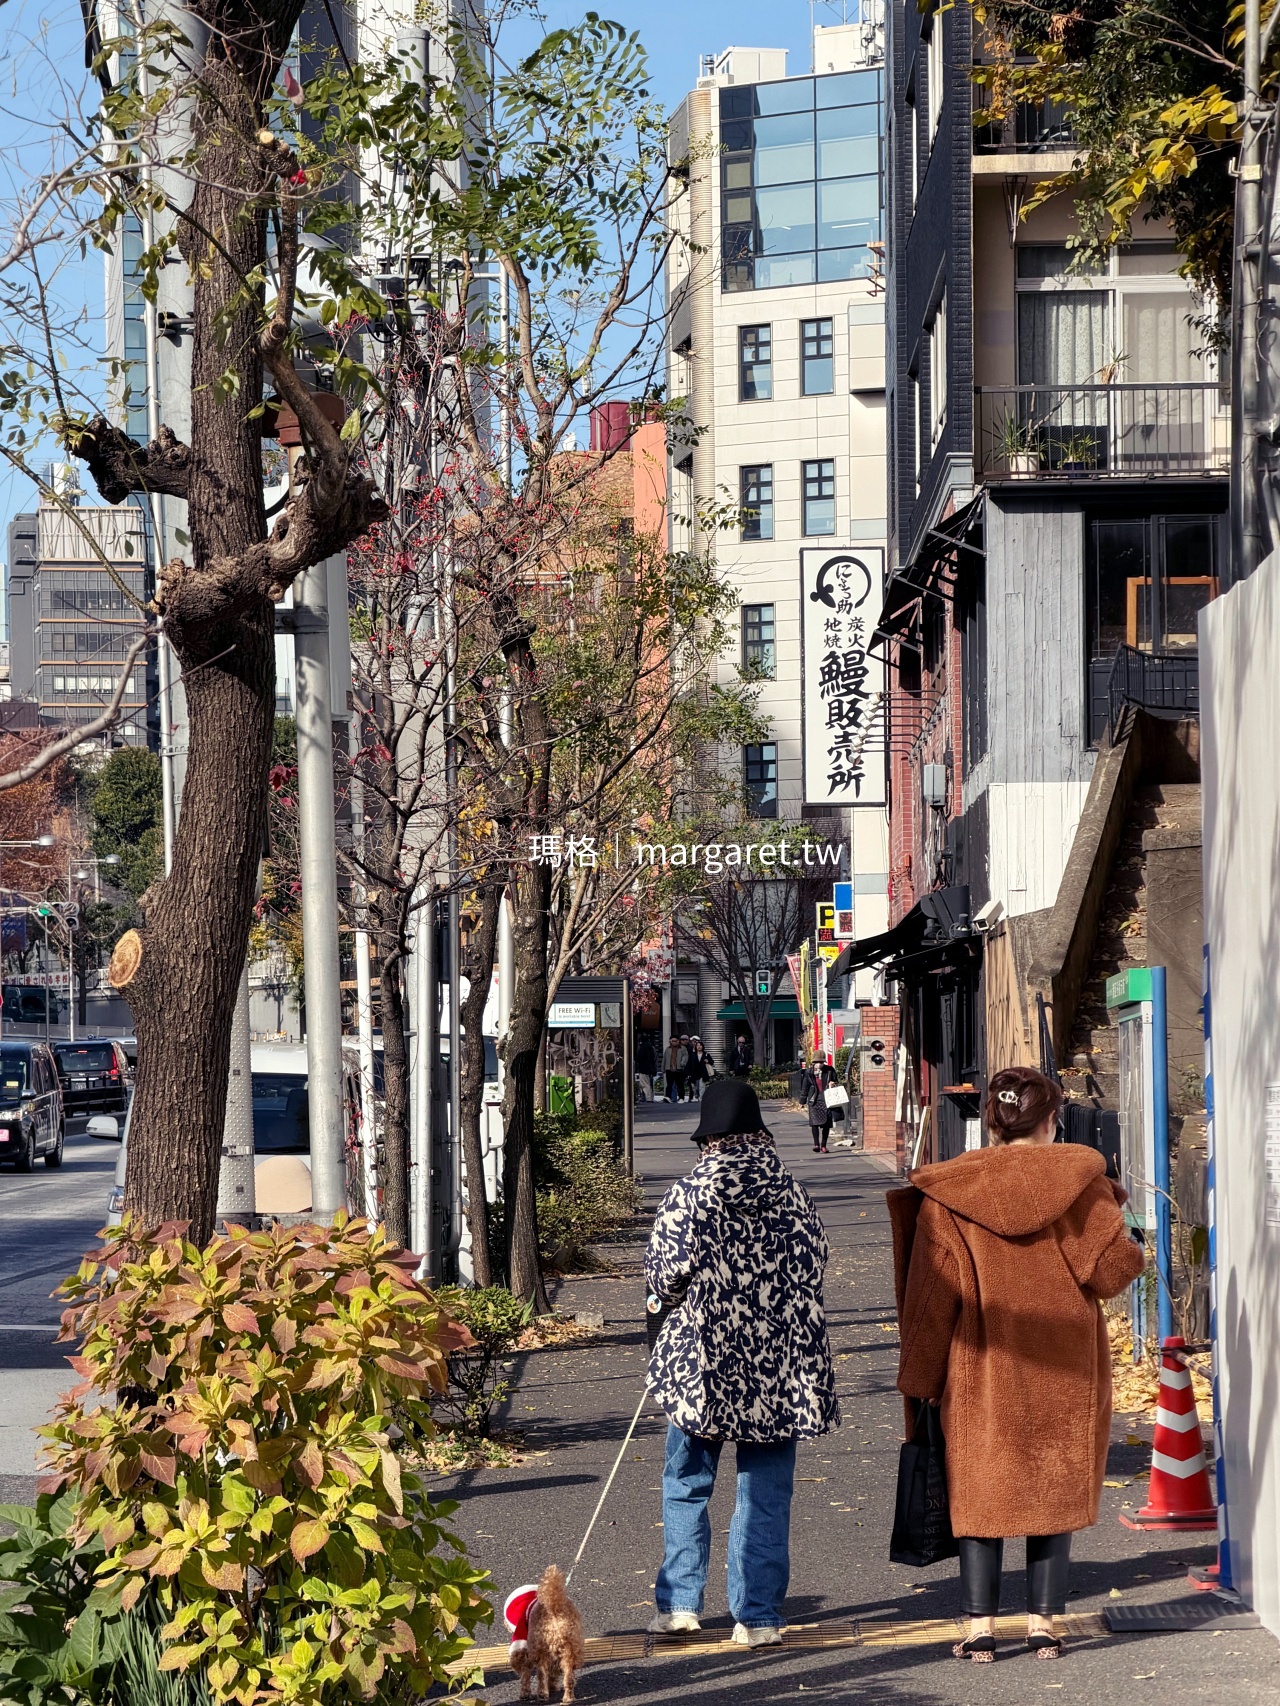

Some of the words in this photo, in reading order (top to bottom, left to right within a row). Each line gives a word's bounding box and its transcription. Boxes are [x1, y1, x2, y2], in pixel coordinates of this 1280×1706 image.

[823, 616, 843, 649] 地焼
[847, 616, 866, 649] 炭火
[818, 649, 873, 799] 鰻販売所
[820, 906, 834, 926] P
